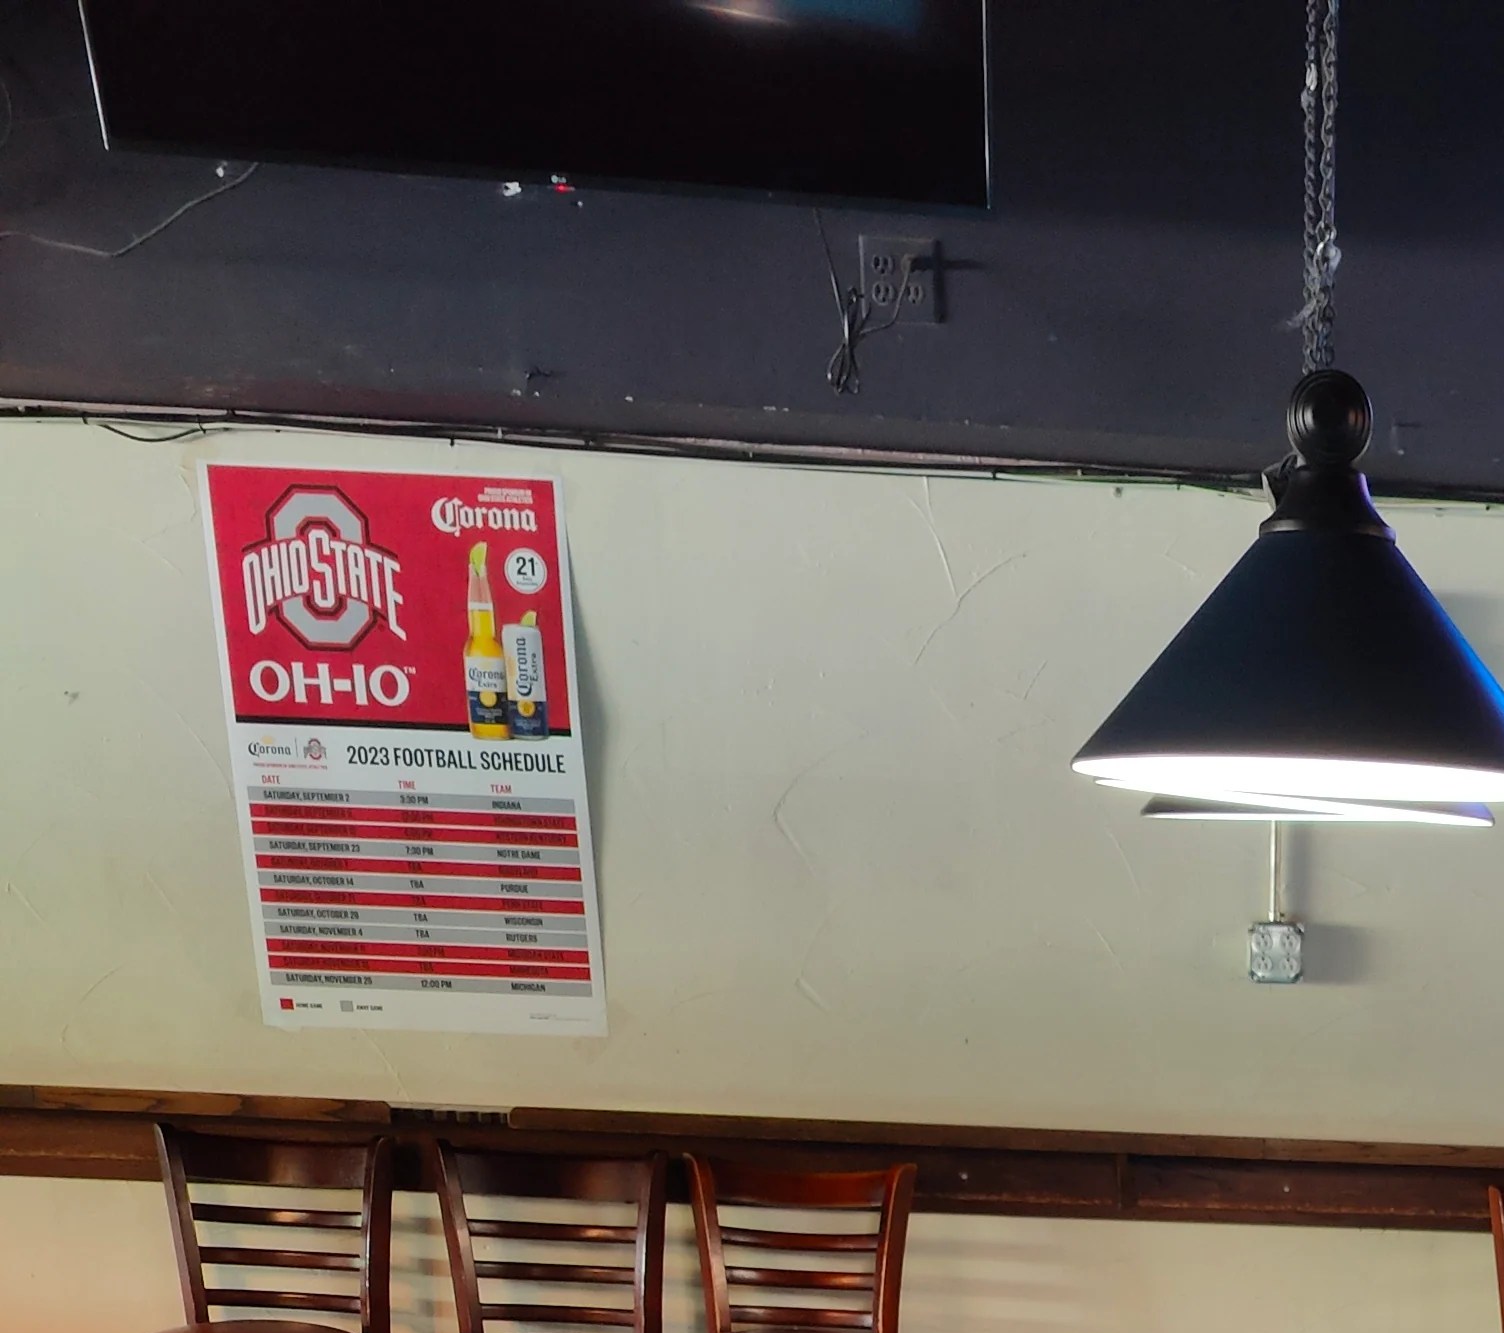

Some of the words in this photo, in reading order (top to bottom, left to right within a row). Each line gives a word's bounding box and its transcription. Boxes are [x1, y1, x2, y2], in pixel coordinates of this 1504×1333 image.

[431, 497, 538, 537] Corona
[516, 637, 533, 697] Corona
[248, 742, 291, 758] Corona
[346, 745, 390, 766] 2023
[394, 747, 477, 770] FOOTBALL
[480, 751, 566, 774] SCHEDULE
[261, 775, 280, 784] DATE
[398, 780, 416, 790] TIME
[490, 784, 512, 794] TEAM
[417, 796, 429, 804] PM
[492, 800, 521, 810] INDIANA
[422, 846, 434, 856] PM
[312, 876, 345, 886] OCTOBER
[500, 883, 528, 894] PURDUE
[316, 909, 350, 920] OCTOBER
[319, 926, 357, 937] NOVEMBER
[506, 933, 538, 943] RUTGERS
[325, 975, 363, 985] NOVEMBER
[441, 980, 452, 989] PM
[511, 982, 546, 993] MICHIGAN
